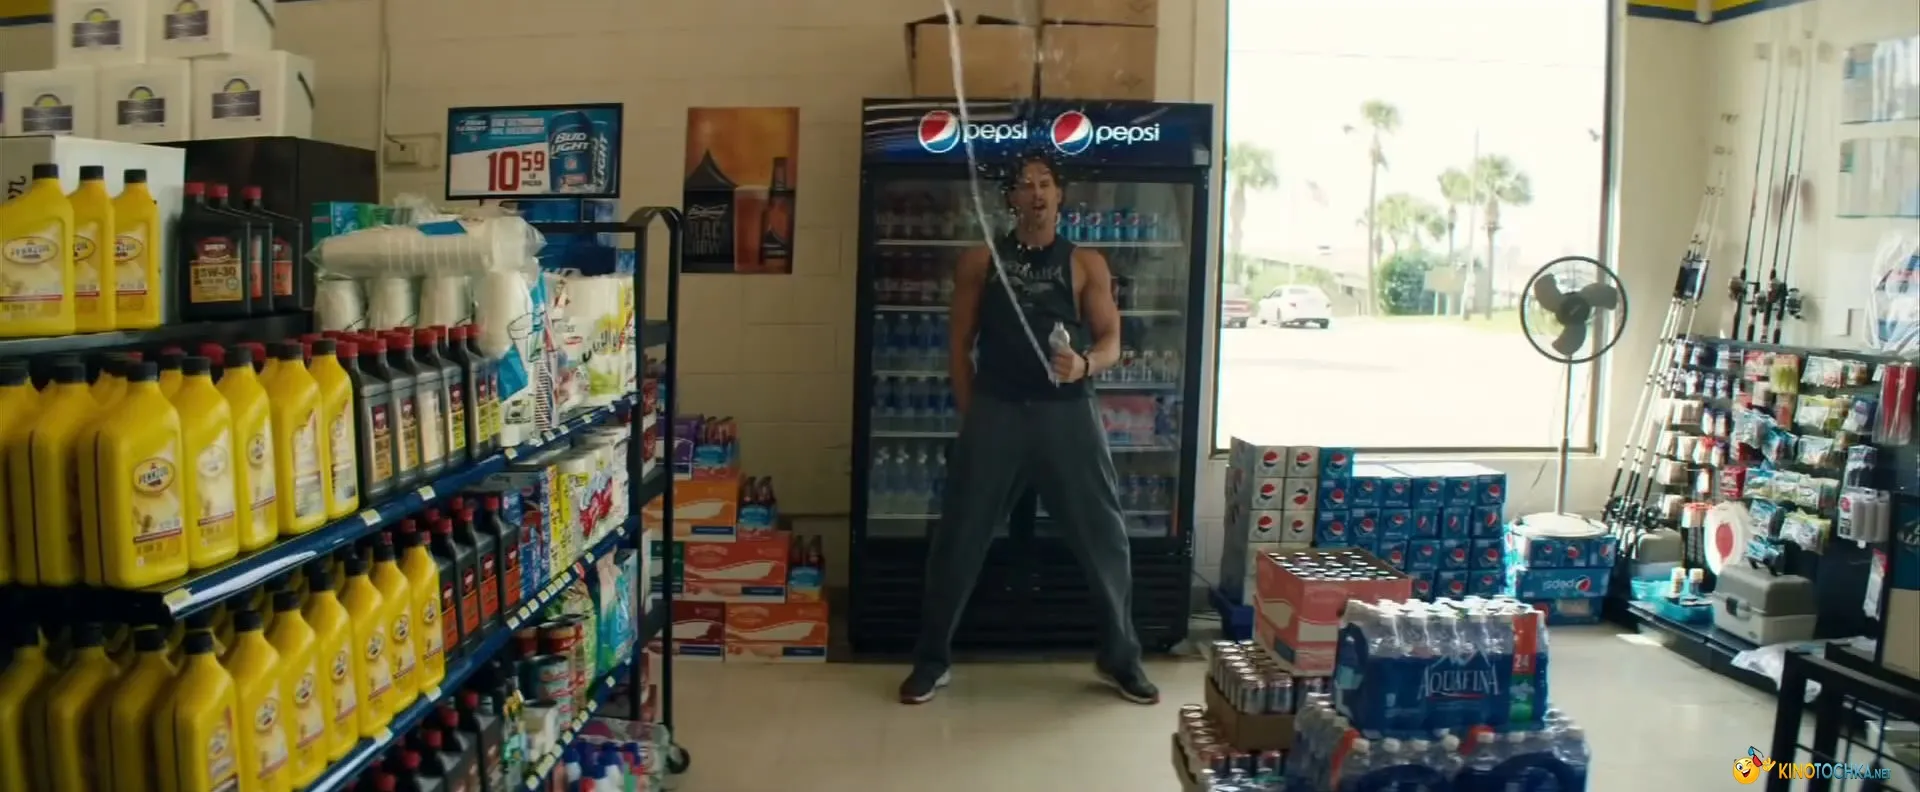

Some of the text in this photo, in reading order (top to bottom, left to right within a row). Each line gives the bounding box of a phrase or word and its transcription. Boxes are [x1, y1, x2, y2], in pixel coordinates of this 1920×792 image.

[555, 132, 587, 142] BUD
[963, 121, 1028, 143] pepsi
[1096, 123, 1160, 145] pepsi
[551, 142, 591, 157] LIGHT
[487, 150, 545, 191] 10 59
[1513, 653, 1530, 669] 24
[1417, 662, 1500, 700] AQUAFINA
